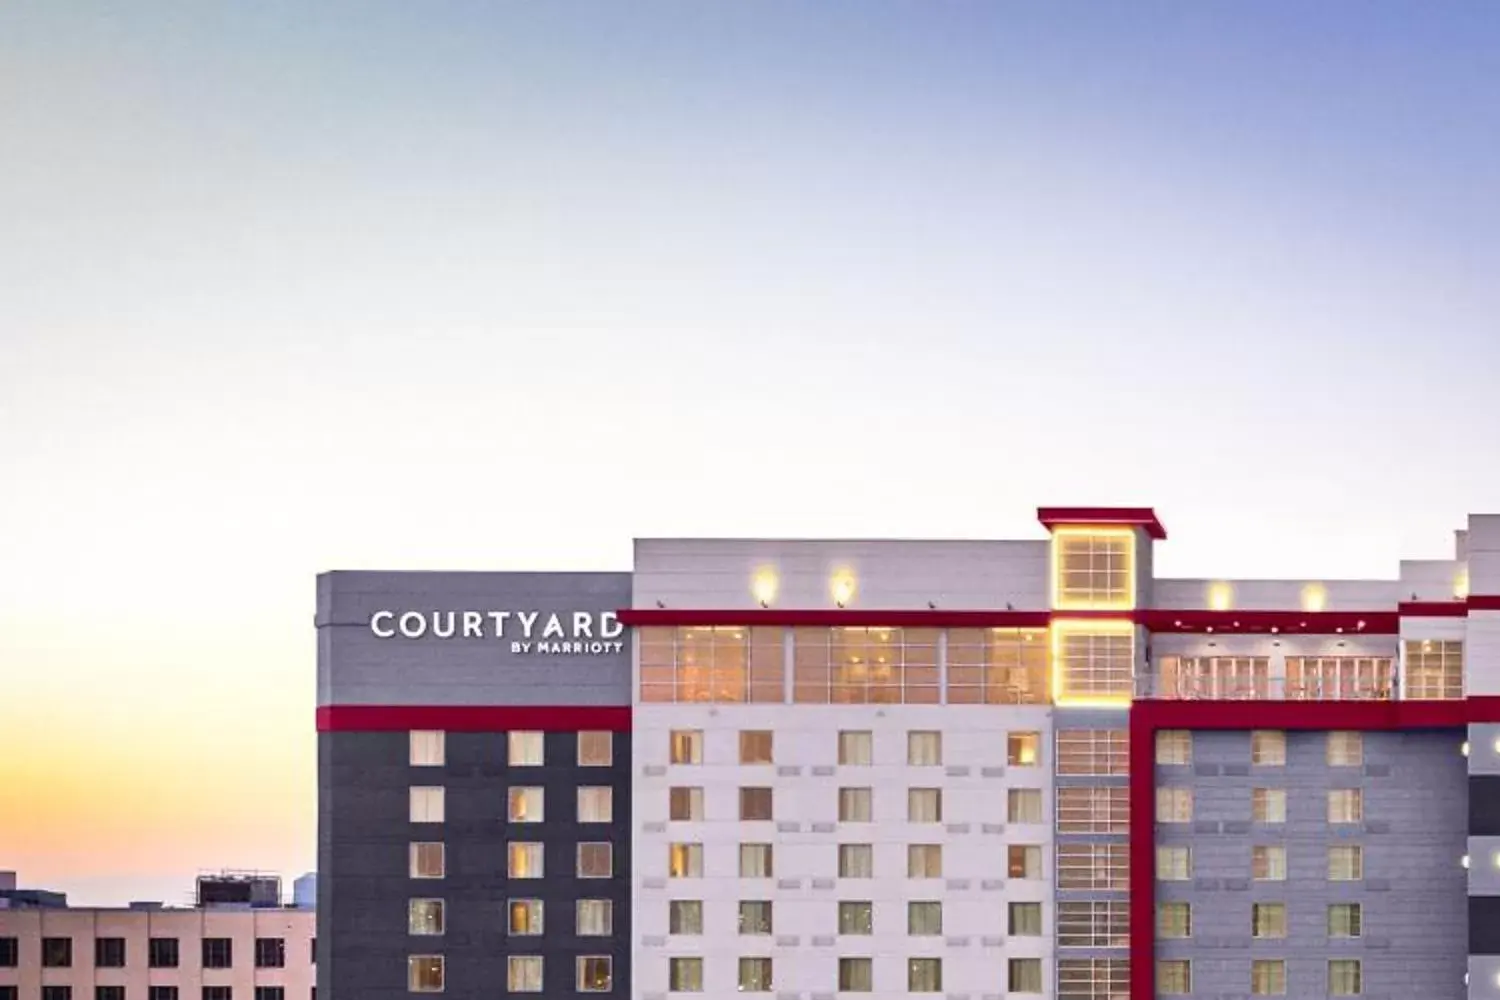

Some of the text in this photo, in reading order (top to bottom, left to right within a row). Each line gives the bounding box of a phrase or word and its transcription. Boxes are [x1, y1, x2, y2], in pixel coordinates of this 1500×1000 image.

[370, 610, 624, 638] COURTYARD
[511, 641, 624, 654] BY MARRIOTT
